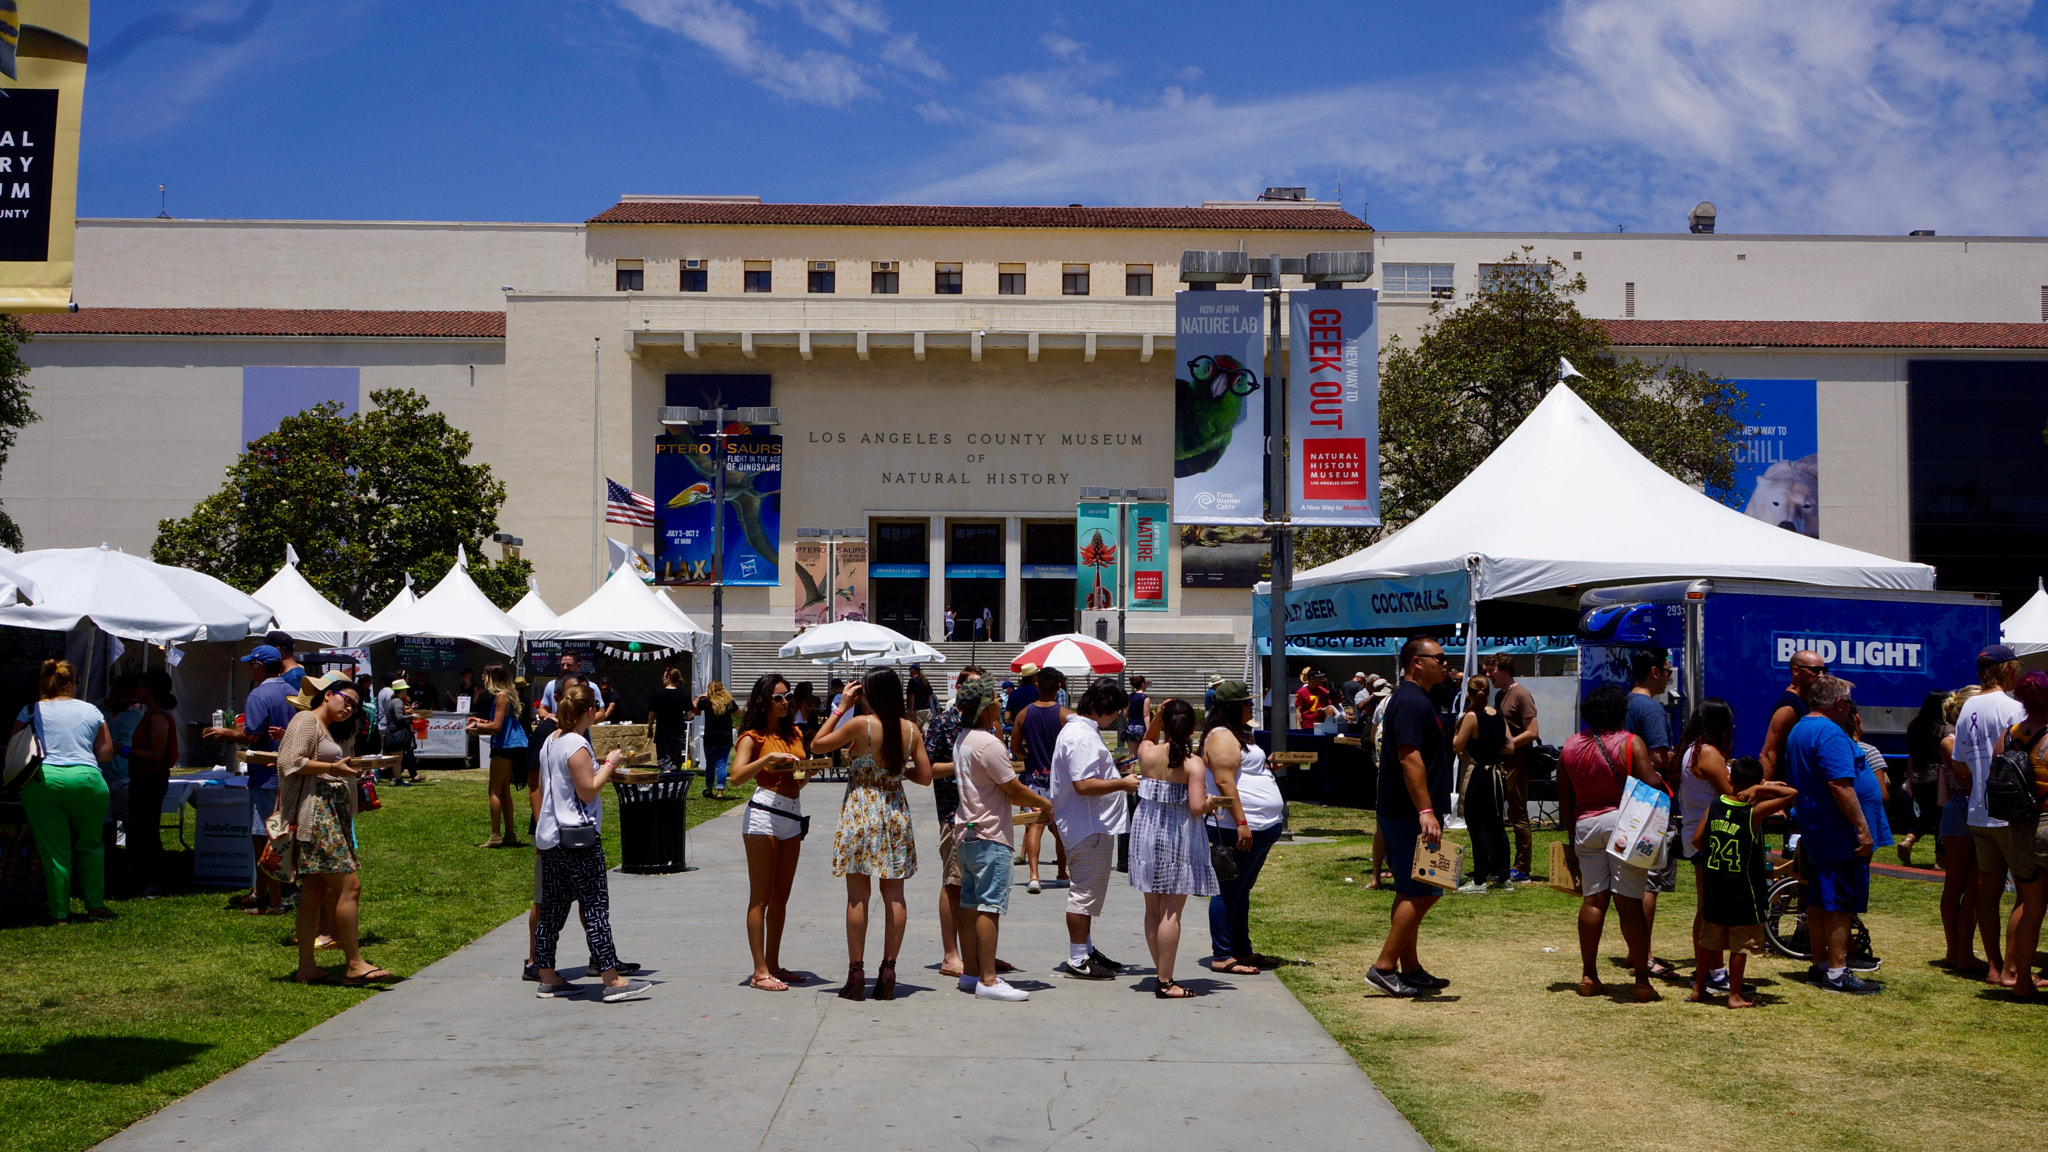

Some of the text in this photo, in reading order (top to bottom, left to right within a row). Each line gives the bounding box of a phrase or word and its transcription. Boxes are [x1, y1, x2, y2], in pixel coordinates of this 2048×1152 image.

[0, 182, 30, 198] M
[1200, 304, 1239, 314] NOW AT NHM
[1181, 316, 1258, 334] NATURE LAB
[1346, 346, 1358, 367] NEW
[1309, 309, 1342, 430] GEEK OUT
[1346, 368, 1358, 388] WAY
[1346, 389, 1358, 402] TO
[1743, 426, 1759, 435] NEW
[1761, 426, 1776, 435] WAY
[1778, 426, 1787, 435] TO
[809, 432, 1142, 445] LOS ANGELES COUNTY MUSEUM
[656, 444, 781, 454] PTERO SAURS
[1735, 440, 1789, 463] CHILL
[967, 454, 985, 463] OF
[727, 463, 780, 471] OF DINOSAURS
[882, 472, 1069, 484] NATURAL HISTORY
[1137, 517, 1152, 562] NATURE
[664, 560, 706, 581] LAX
[1304, 598, 1338, 620] BEER
[1372, 588, 1449, 614] COCKTAILS
[532, 641, 562, 649] Waffling
[1267, 637, 1386, 648] XOLOGY BAR
[1494, 636, 1527, 646] BAR
[1777, 637, 1921, 666] BUD LIGHT
[424, 721, 463, 730] iablo
[1707, 836, 1741, 872] 24
